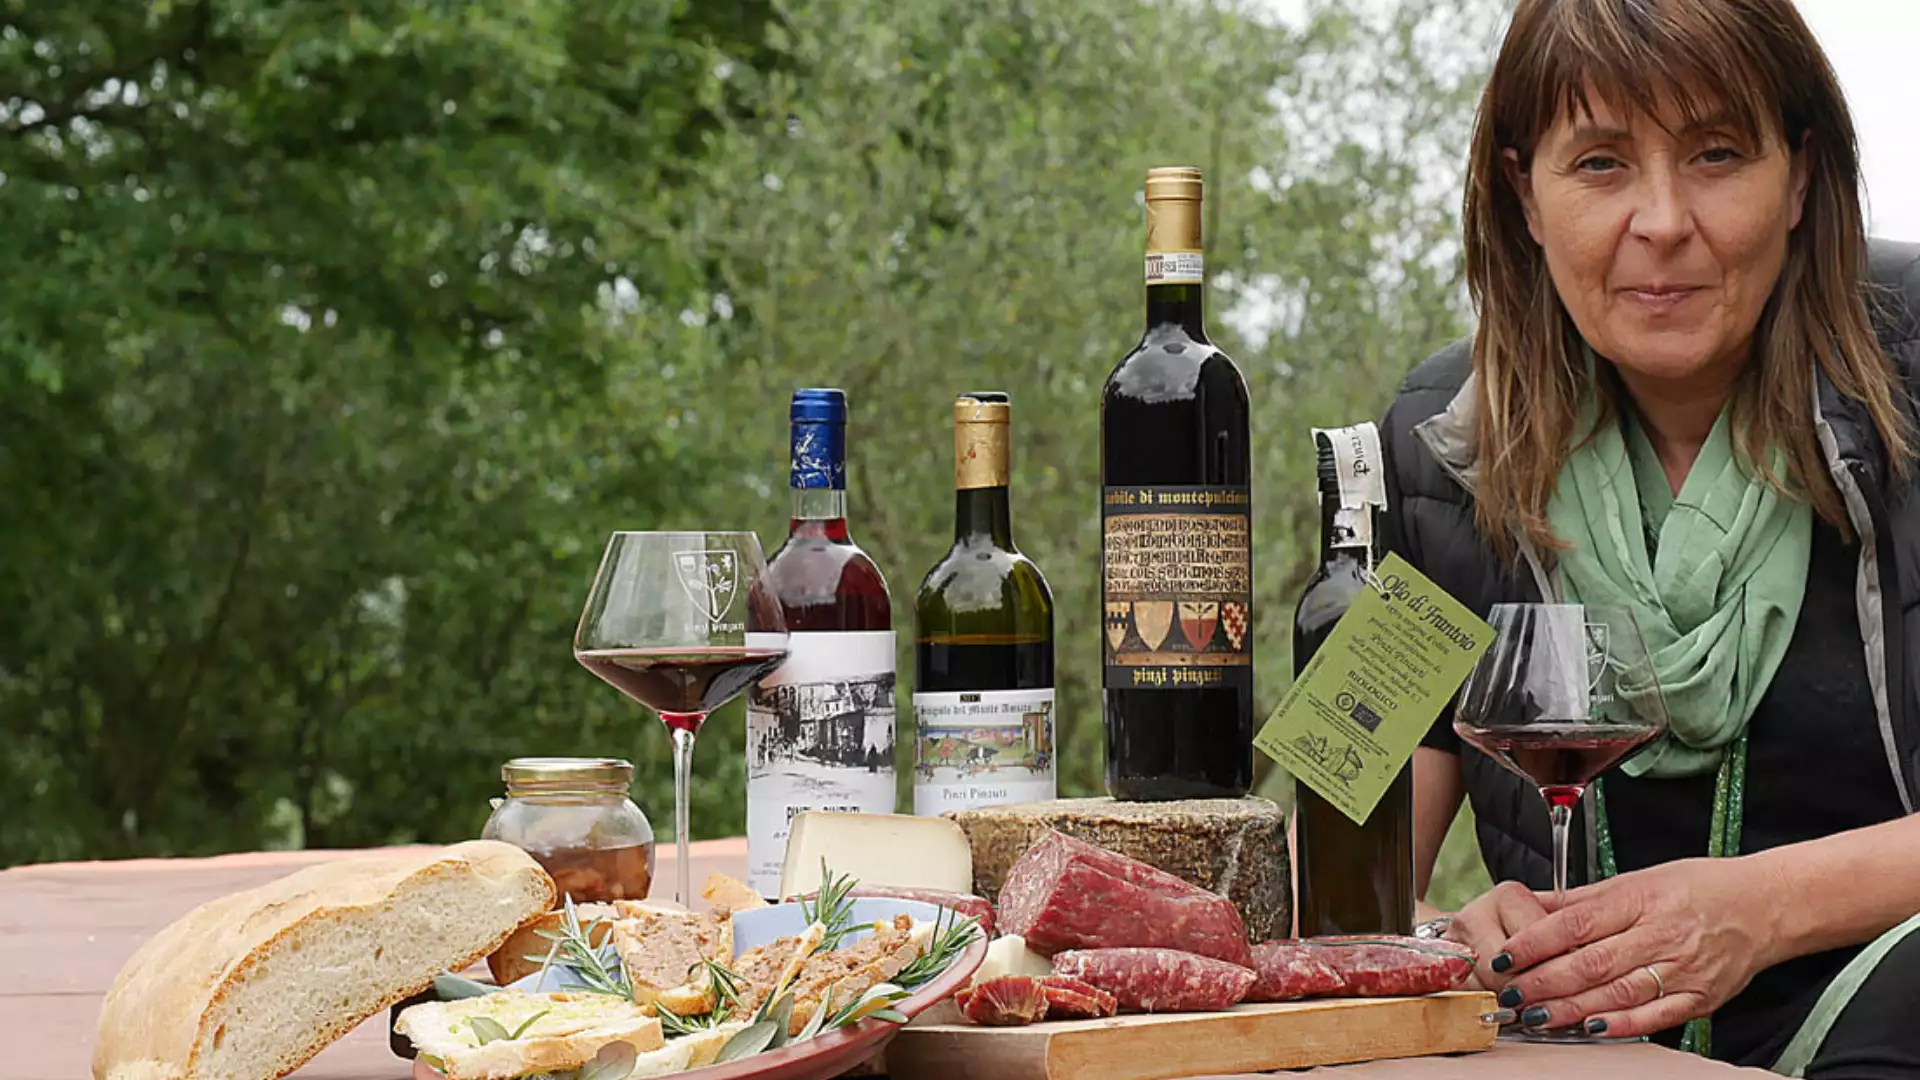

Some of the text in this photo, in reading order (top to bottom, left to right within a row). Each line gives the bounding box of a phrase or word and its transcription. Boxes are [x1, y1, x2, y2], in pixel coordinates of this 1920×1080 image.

[1138, 489, 1153, 504] di
[1382, 572, 1408, 601] Olio
[1405, 593, 1428, 613] di
[1418, 604, 1477, 652] Frantoio
[1133, 667, 1222, 686] pinzi pinzuti
[1348, 671, 1397, 709] BIOLOGICO
[942, 787, 1007, 800] Pinzi Pinzuti
